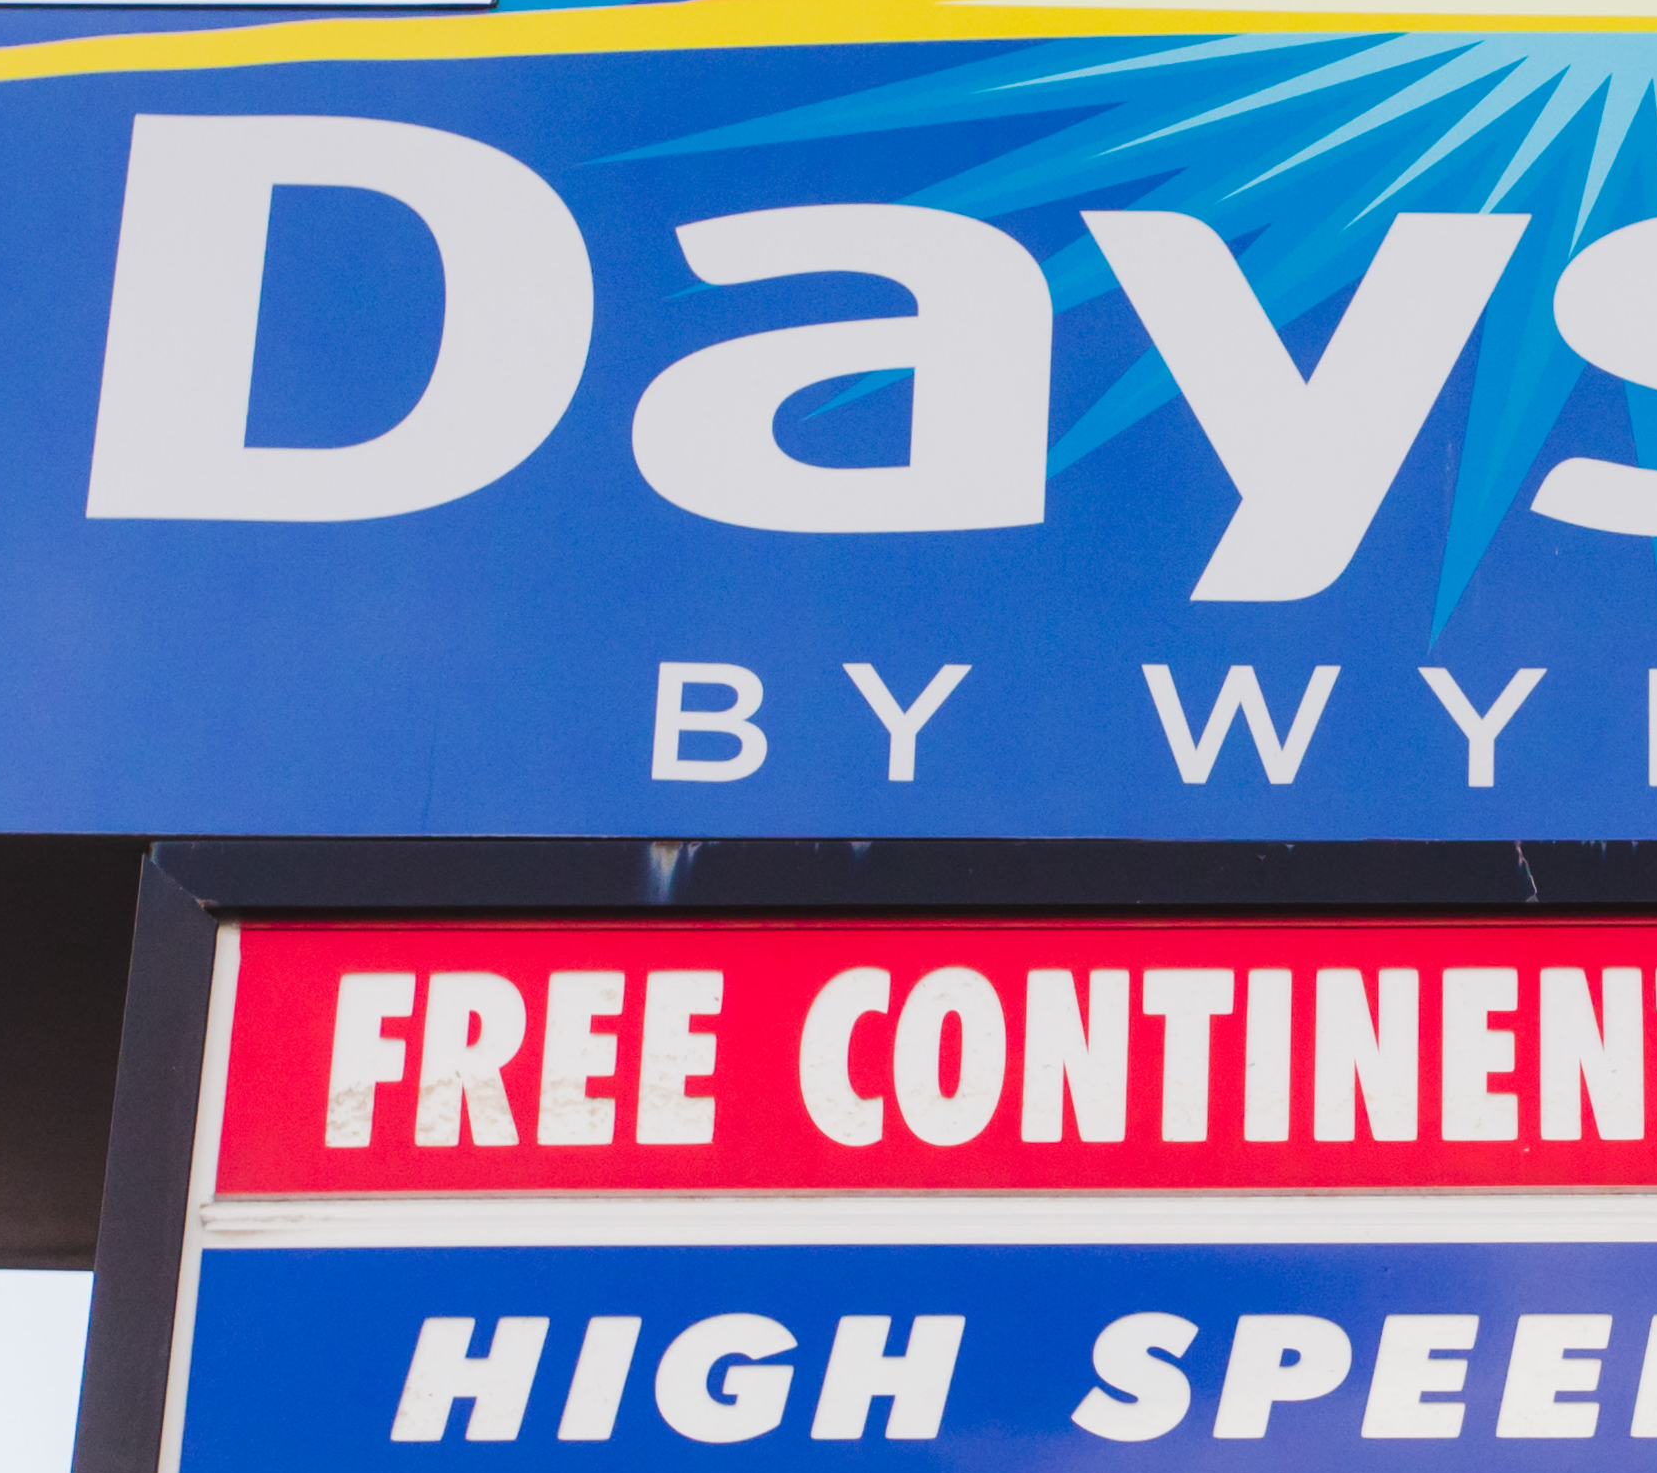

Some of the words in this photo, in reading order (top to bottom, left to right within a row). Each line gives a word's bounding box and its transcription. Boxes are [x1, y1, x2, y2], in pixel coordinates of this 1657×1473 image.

[652, 662, 972, 784] BY
[324, 971, 724, 1149] FREE
[390, 1313, 966, 1444] HIGH
